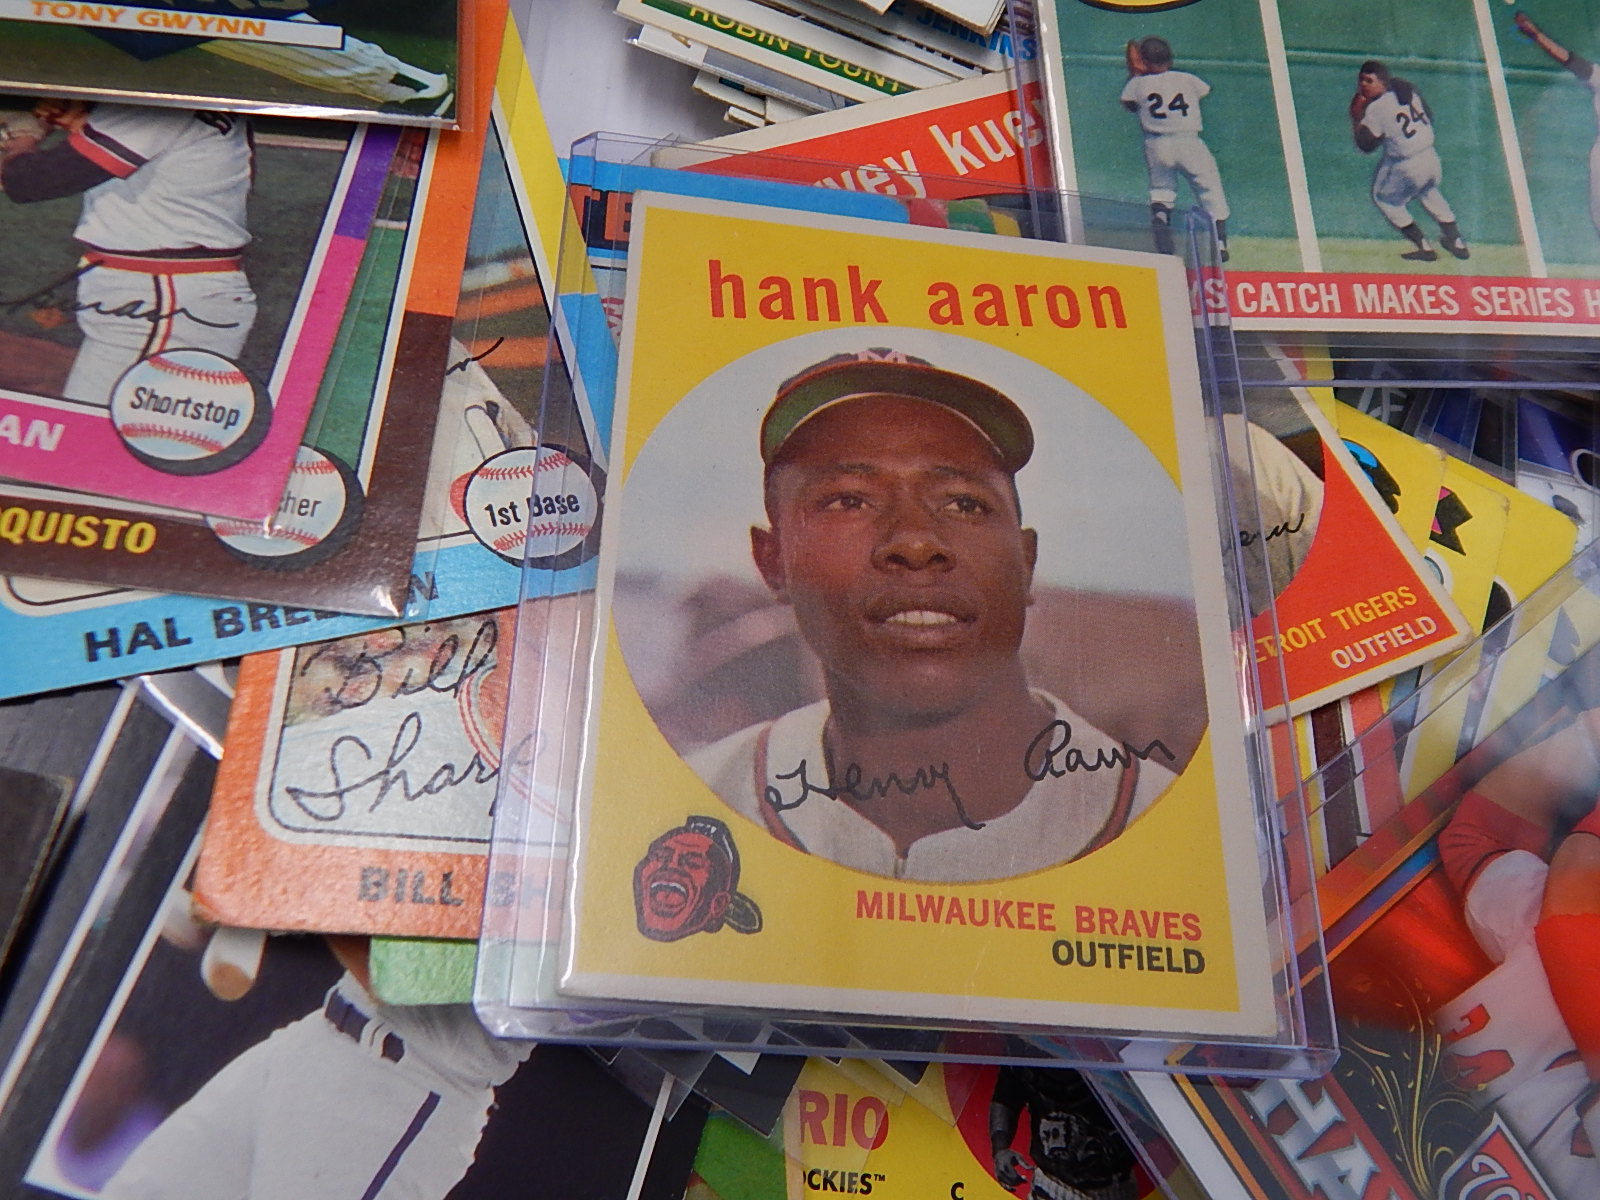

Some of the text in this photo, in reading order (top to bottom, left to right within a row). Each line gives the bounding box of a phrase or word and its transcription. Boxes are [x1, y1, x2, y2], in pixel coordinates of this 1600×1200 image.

[31, 1, 126, 24] TONY
[137, 11, 267, 37] GWYNN
[1147, 92, 1189, 119] 24
[1396, 104, 1428, 139] 24
[812, 98, 1046, 199] vey kue
[708, 259, 1128, 329] hank aaron
[1236, 282, 1341, 314] CATCH
[1353, 284, 1460, 316] MAKES
[1471, 286, 1575, 318] SERIES
[130, 386, 240, 429] Shortstop
[279, 491, 321, 518] her
[484, 501, 521, 527] 1st
[1331, 585, 1417, 631] TIGERS
[85, 617, 192, 662] HAL
[1331, 616, 1437, 669] OUTFIELD
[358, 866, 464, 907] BILL
[856, 890, 1204, 942] MILWAUKEE BRAVES
[1052, 939, 1206, 975] OUTFIELD
